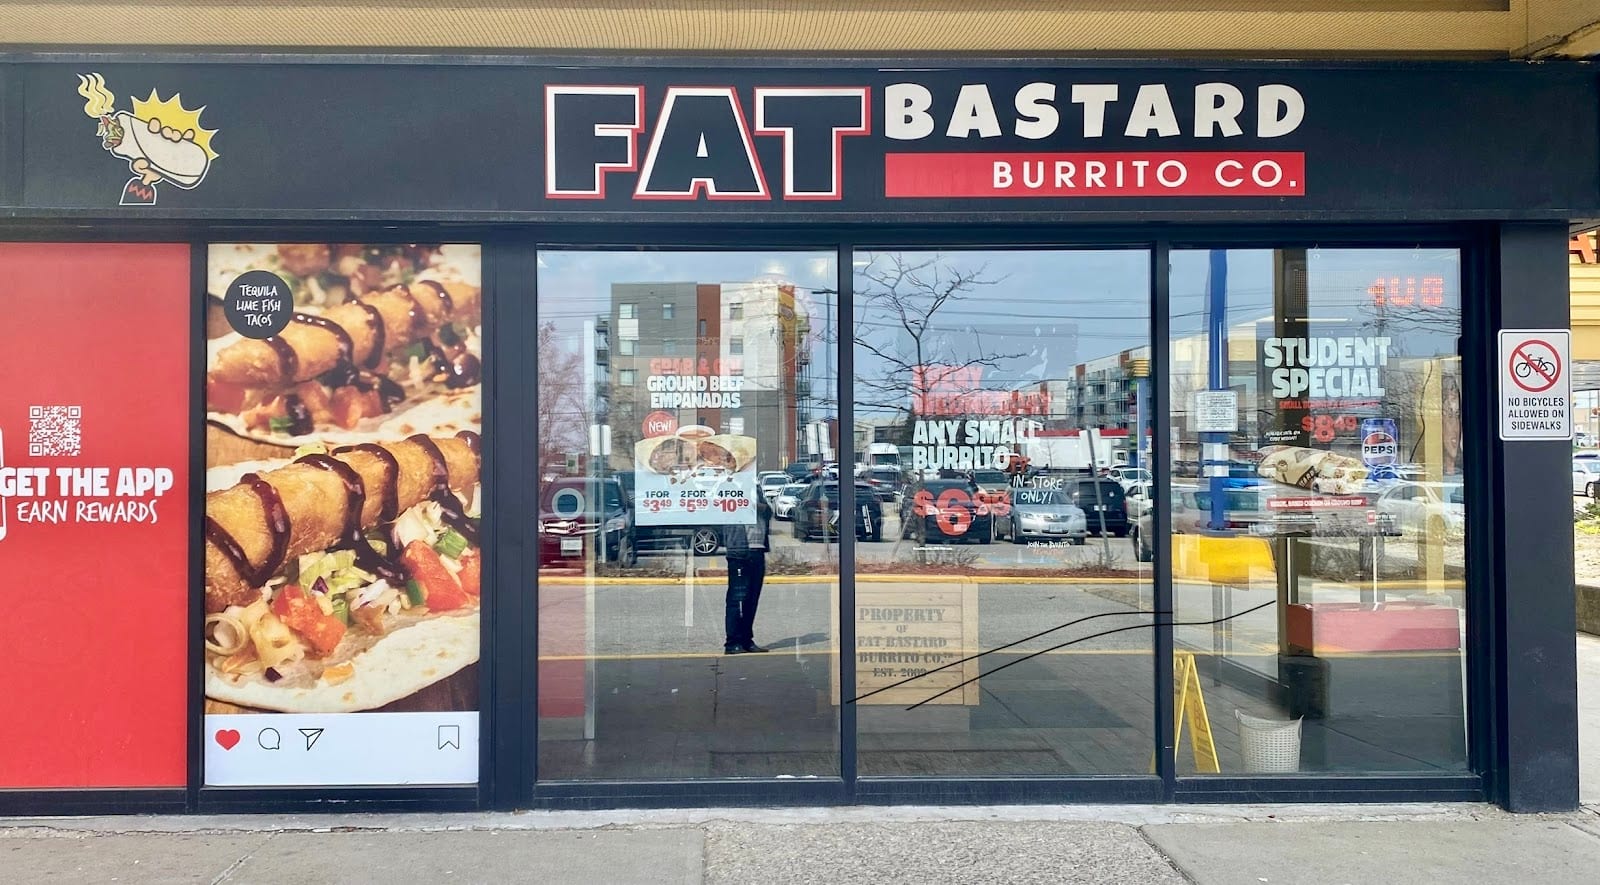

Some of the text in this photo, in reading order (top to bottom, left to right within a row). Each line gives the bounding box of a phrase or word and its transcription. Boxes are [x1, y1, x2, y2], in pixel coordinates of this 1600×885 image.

[884, 82, 1305, 140] BASTARD
[544, 84, 871, 200] FAT
[993, 159, 1297, 188] BURRITO CO.
[239, 284, 278, 297] TEQUILA
[236, 299, 281, 312] LIME FISH
[244, 314, 272, 327] TACOS
[1264, 337, 1391, 367] STUDENT
[647, 376, 744, 391] GROUND BEEF
[1272, 367, 1385, 398] SPECIAL
[651, 392, 741, 408] EMPANADAS
[1508, 398, 1564, 406] NO BICYCLES
[1508, 410, 1564, 418] ALLOWED ON
[649, 421, 672, 434] NEW!
[912, 420, 1041, 444] ANY SMALL
[1512, 421, 1561, 430] SIDEWALKS
[912, 446, 1011, 470] BURRITO
[0, 467, 174, 497] GET THE APP
[1013, 474, 1063, 490] IN-STORE
[1021, 492, 1053, 505] ONLY!
[17, 499, 158, 524] EARN REWARDS
[860, 607, 945, 621] PROPERTY
[896, 625, 907, 633] OF
[858, 636, 948, 648] FAT BASTARD
[860, 652, 919, 663] BURRITO
[873, 667, 896, 677] EST.
